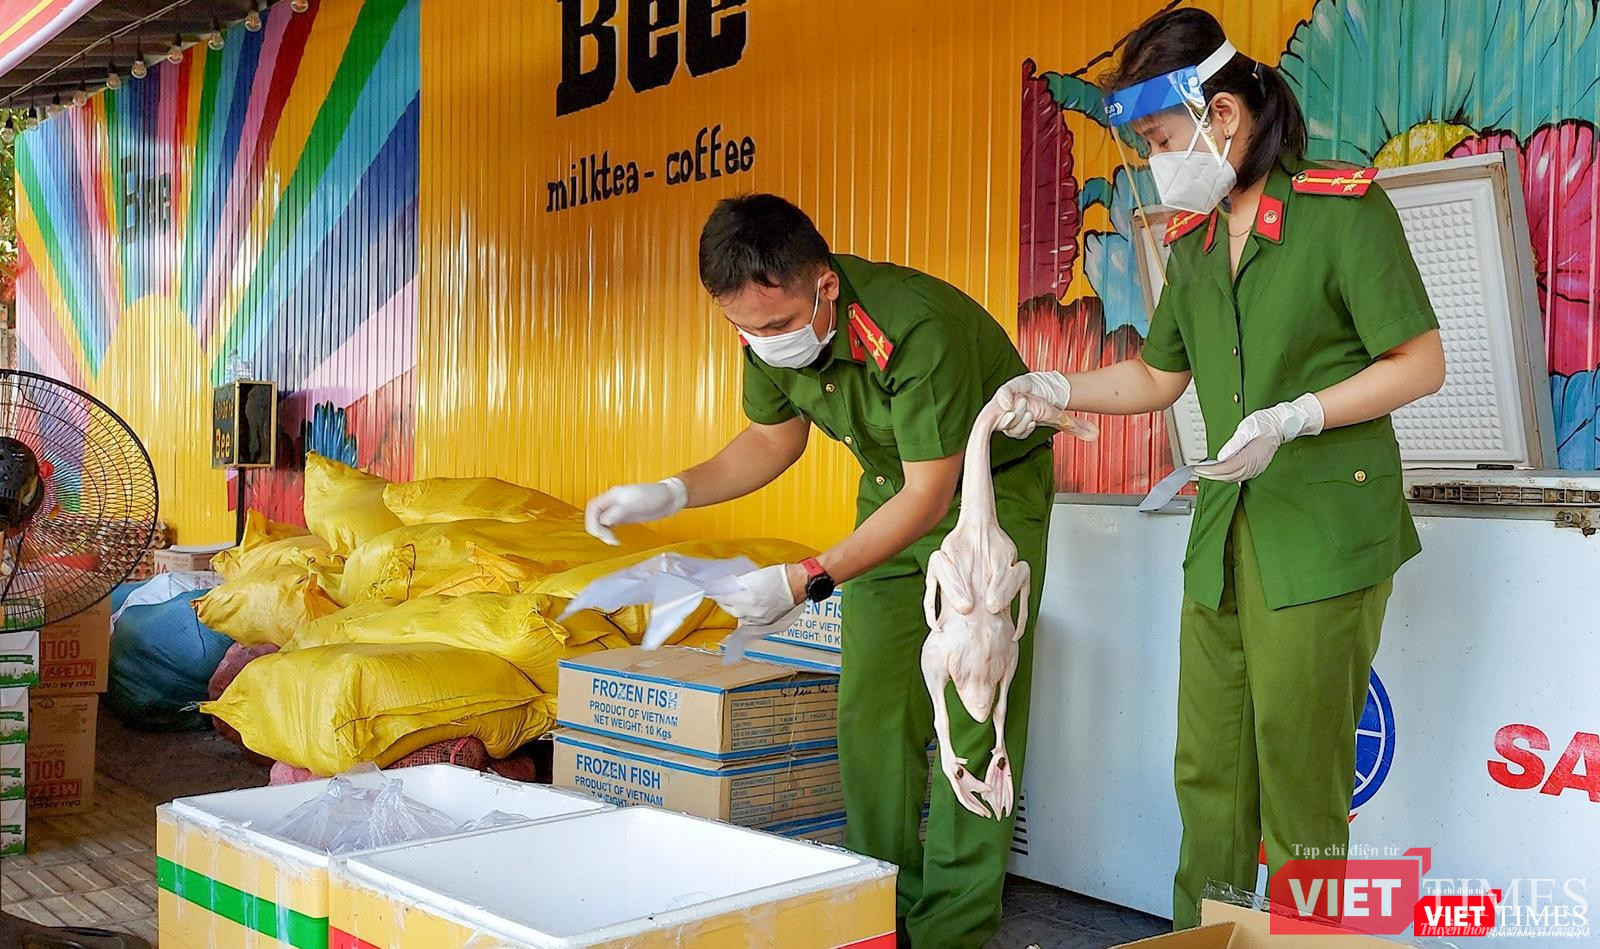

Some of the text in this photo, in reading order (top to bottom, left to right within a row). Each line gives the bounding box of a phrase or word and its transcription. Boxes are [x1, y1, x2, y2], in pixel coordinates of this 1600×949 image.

[556, 0, 748, 118] Bee
[546, 150, 639, 212] milktea
[666, 124, 756, 186] coffee
[215, 428, 231, 459] Bee
[825, 601, 842, 618] FIS
[806, 620, 817, 628] OF
[820, 622, 841, 633] VIET
[824, 634, 833, 643] 10
[592, 678, 643, 703] FROZEN
[589, 700, 678, 727] PRODUCT OF VIETNAM
[594, 714, 609, 726] NET
[645, 725, 654, 736] 10
[656, 726, 672, 740] Kgs
[576, 753, 627, 781] FROZEN
[630, 766, 661, 790] FISH
[574, 775, 612, 793] PRODUCT
[614, 785, 625, 796] OF
[626, 788, 663, 807] VIETNAM
